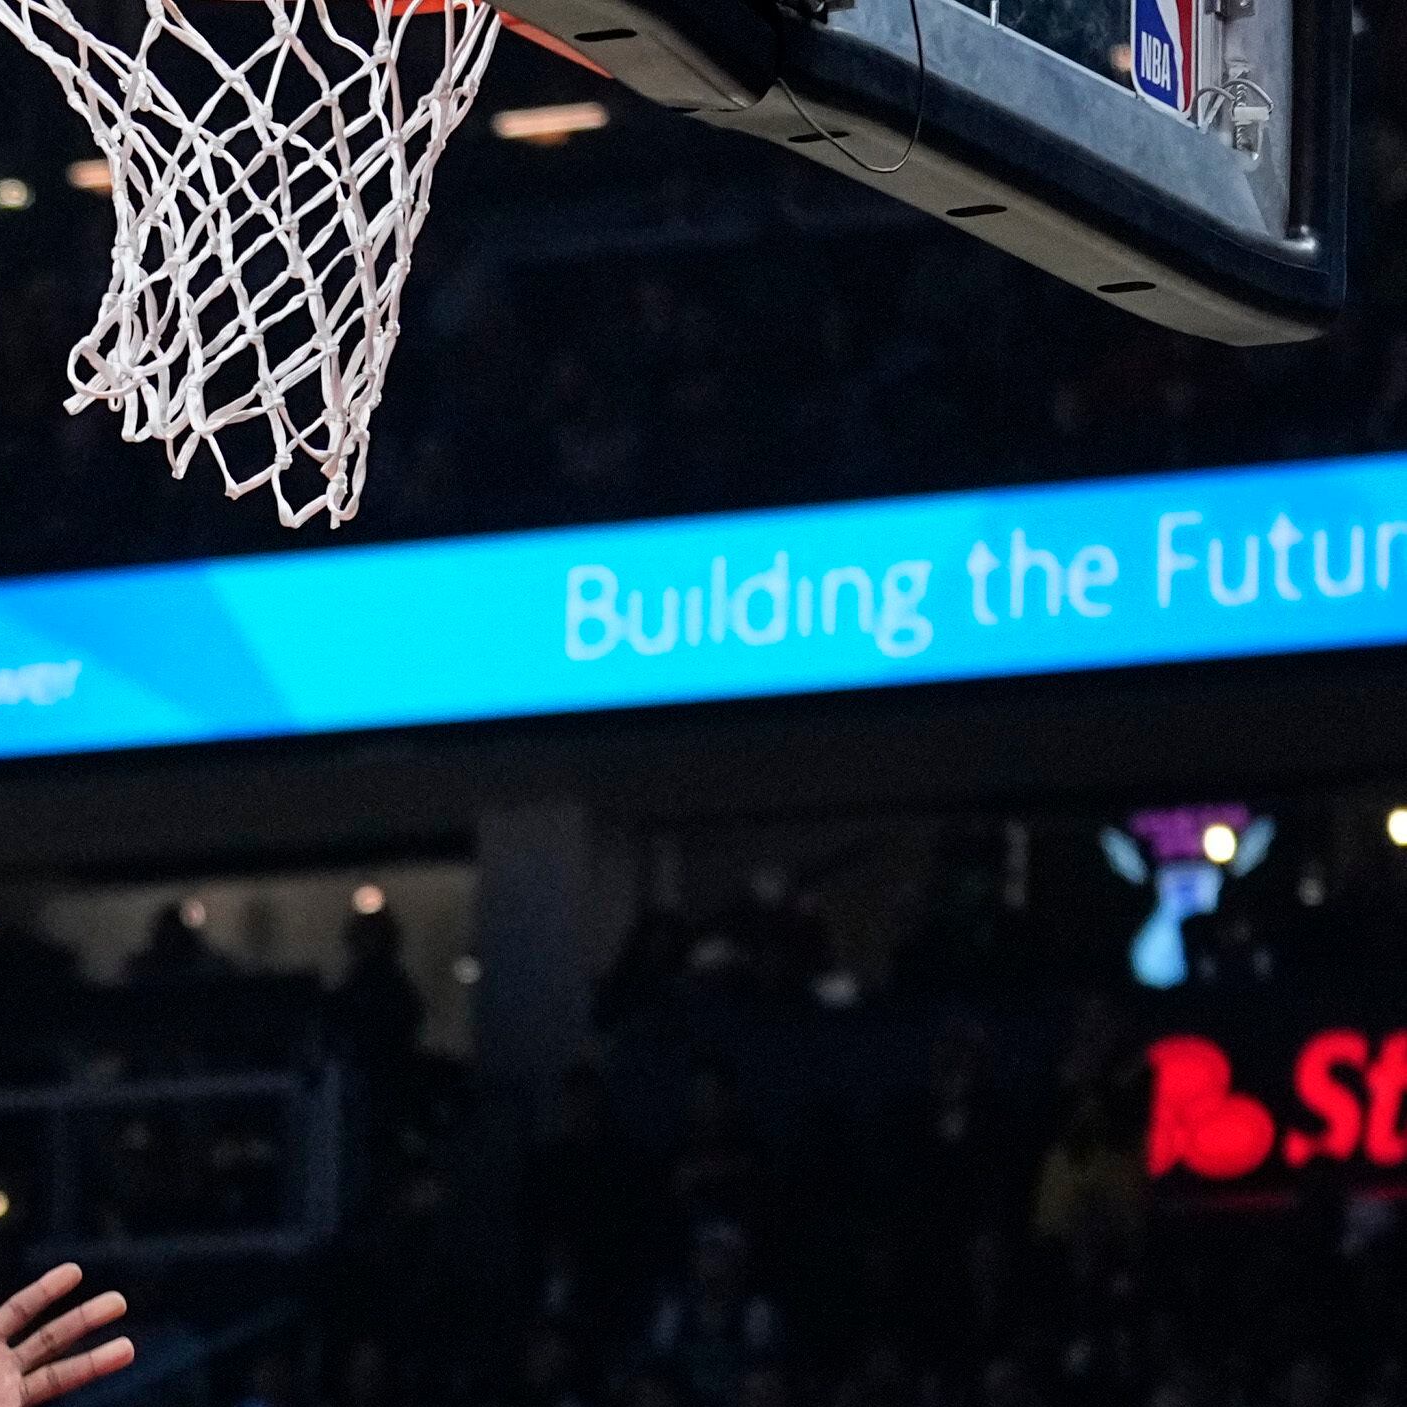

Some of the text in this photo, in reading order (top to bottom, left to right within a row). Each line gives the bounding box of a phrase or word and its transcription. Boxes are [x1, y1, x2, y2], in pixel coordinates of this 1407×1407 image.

[1140, 31, 1171, 92] NBA
[563, 550, 934, 661] Building
[966, 527, 1120, 626] the
